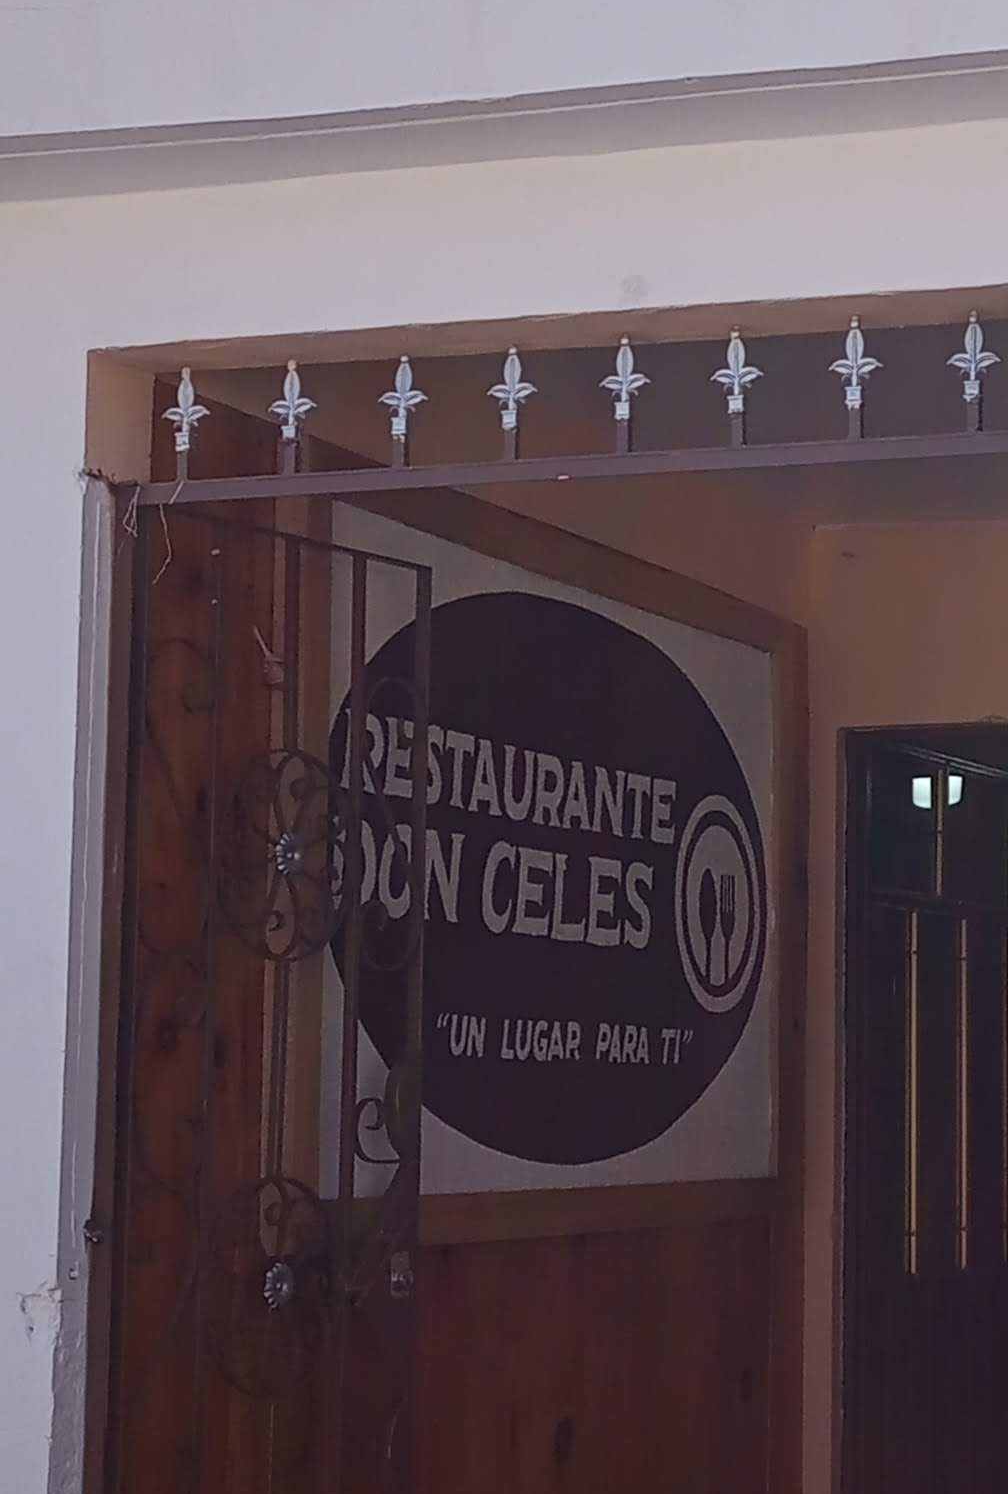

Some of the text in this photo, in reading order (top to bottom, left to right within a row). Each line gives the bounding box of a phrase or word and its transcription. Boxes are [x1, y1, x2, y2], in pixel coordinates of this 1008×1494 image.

[339, 707, 677, 845] RESTAURANTE
[481, 839, 655, 950] CELES
[436, 1012, 694, 1065] “UN LUGAR PARA TI”
